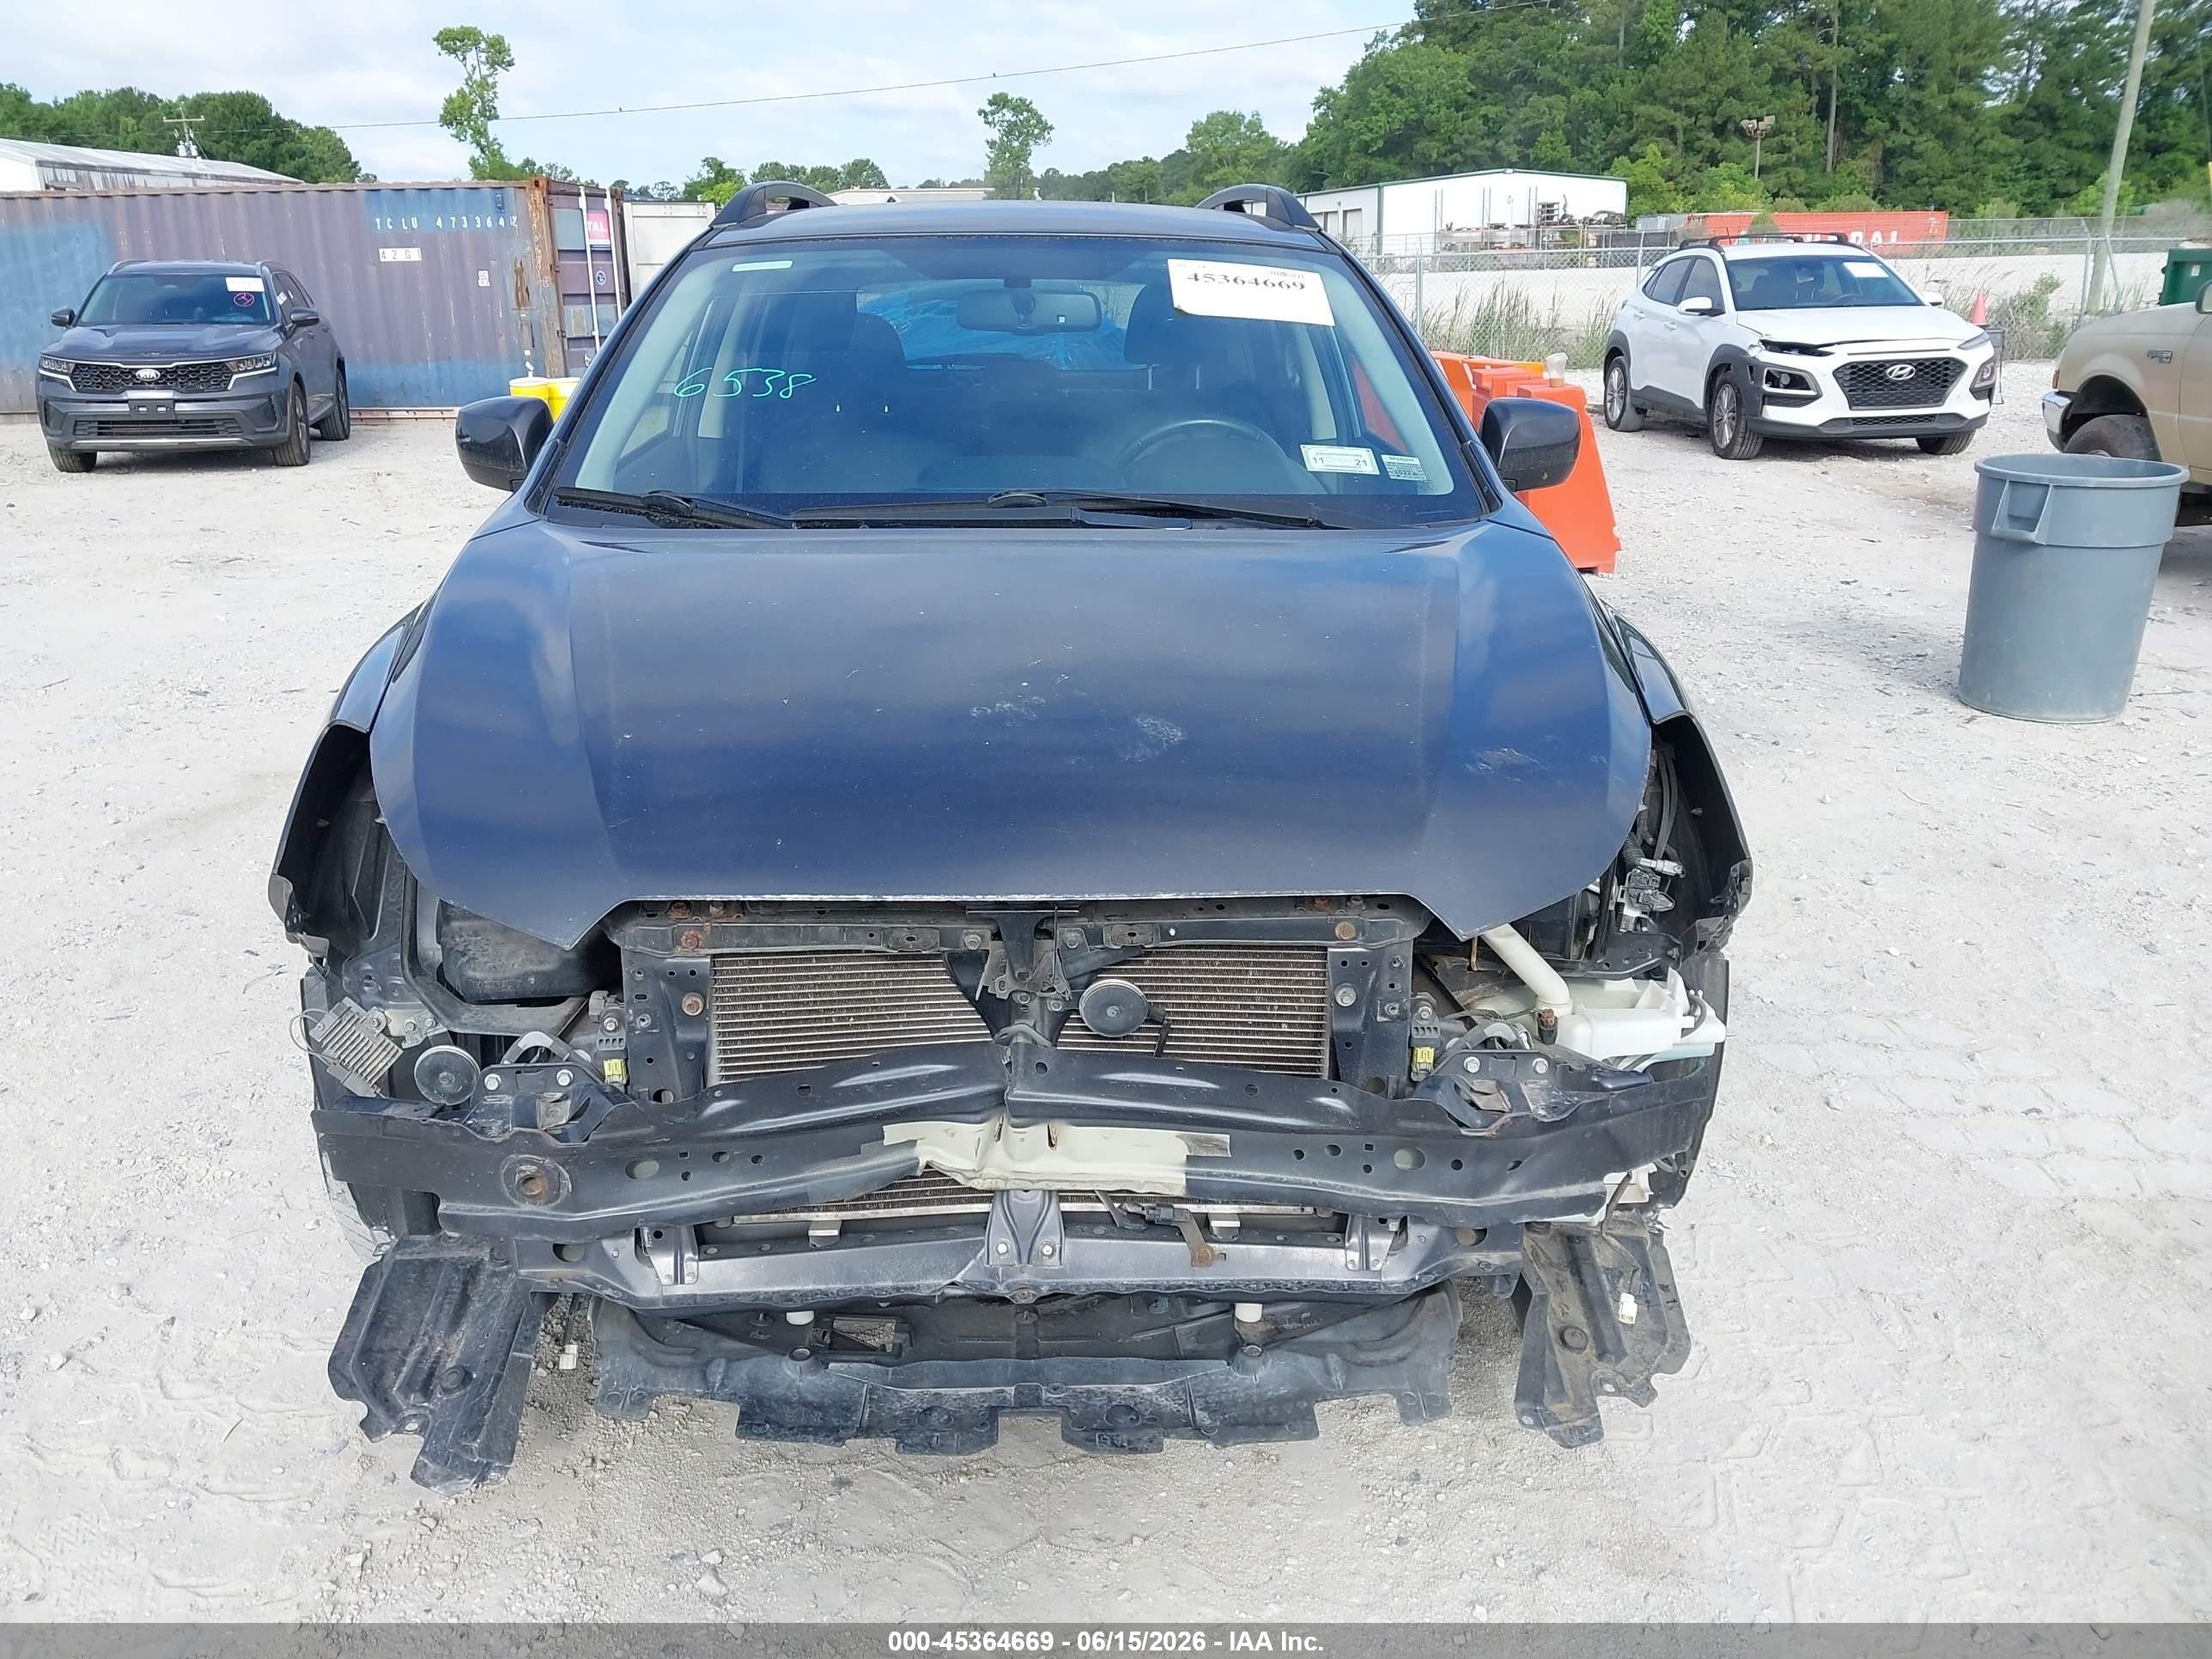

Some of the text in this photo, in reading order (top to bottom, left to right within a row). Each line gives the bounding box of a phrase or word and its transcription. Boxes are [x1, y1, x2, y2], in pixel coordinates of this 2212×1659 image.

[1187, 271, 1306, 290] 45364669
[673, 368, 817, 398] 6538
[1354, 459, 1368, 467] 21
